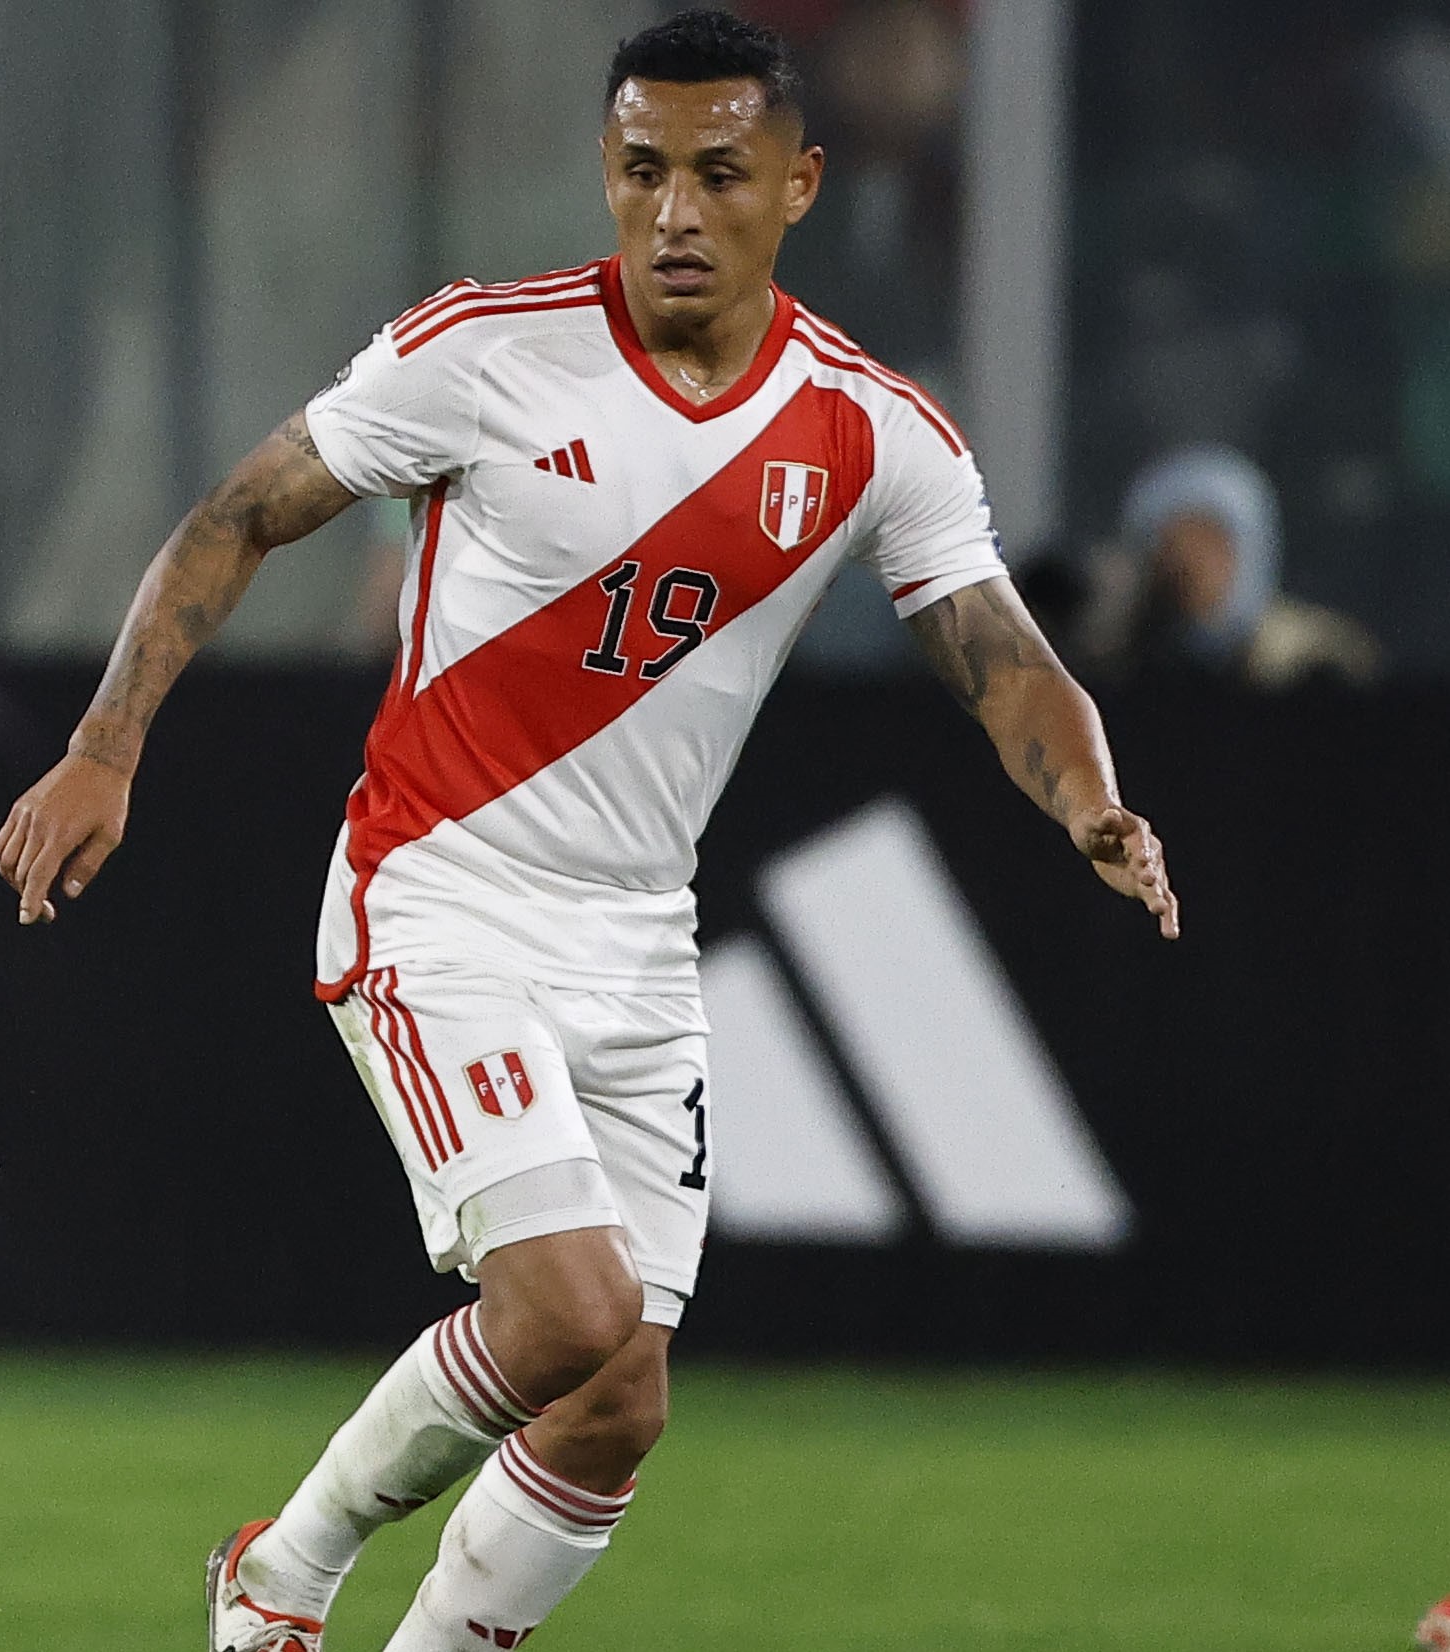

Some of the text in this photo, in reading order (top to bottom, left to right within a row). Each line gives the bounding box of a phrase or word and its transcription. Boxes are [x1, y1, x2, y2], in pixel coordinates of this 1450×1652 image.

[769, 491, 817, 512] FPF
[582, 560, 719, 681] 19
[477, 1070, 524, 1097] FPF
